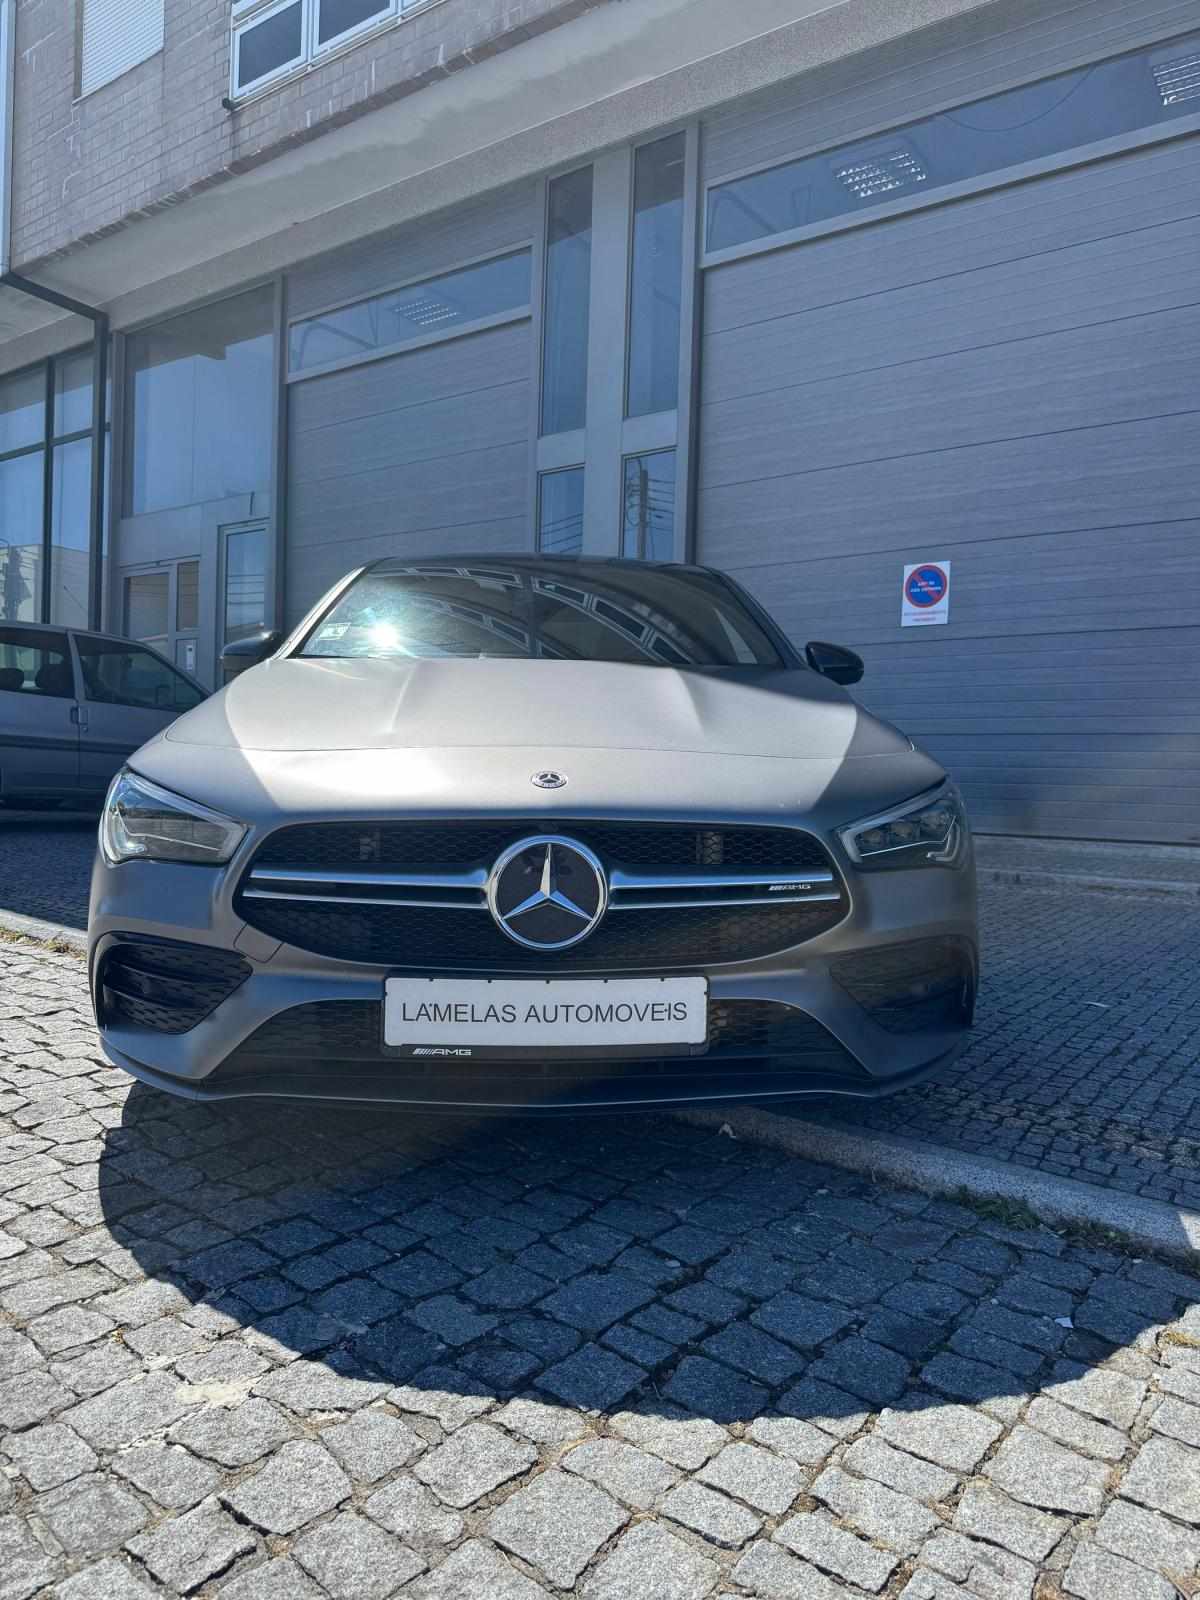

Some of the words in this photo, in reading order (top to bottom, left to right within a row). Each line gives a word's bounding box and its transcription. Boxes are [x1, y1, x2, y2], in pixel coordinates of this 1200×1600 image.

[402, 1002, 517, 1024] LAMELAS
[524, 1002, 688, 1024] AUTOMOVEIS
[431, 1048, 472, 1056] AMG
